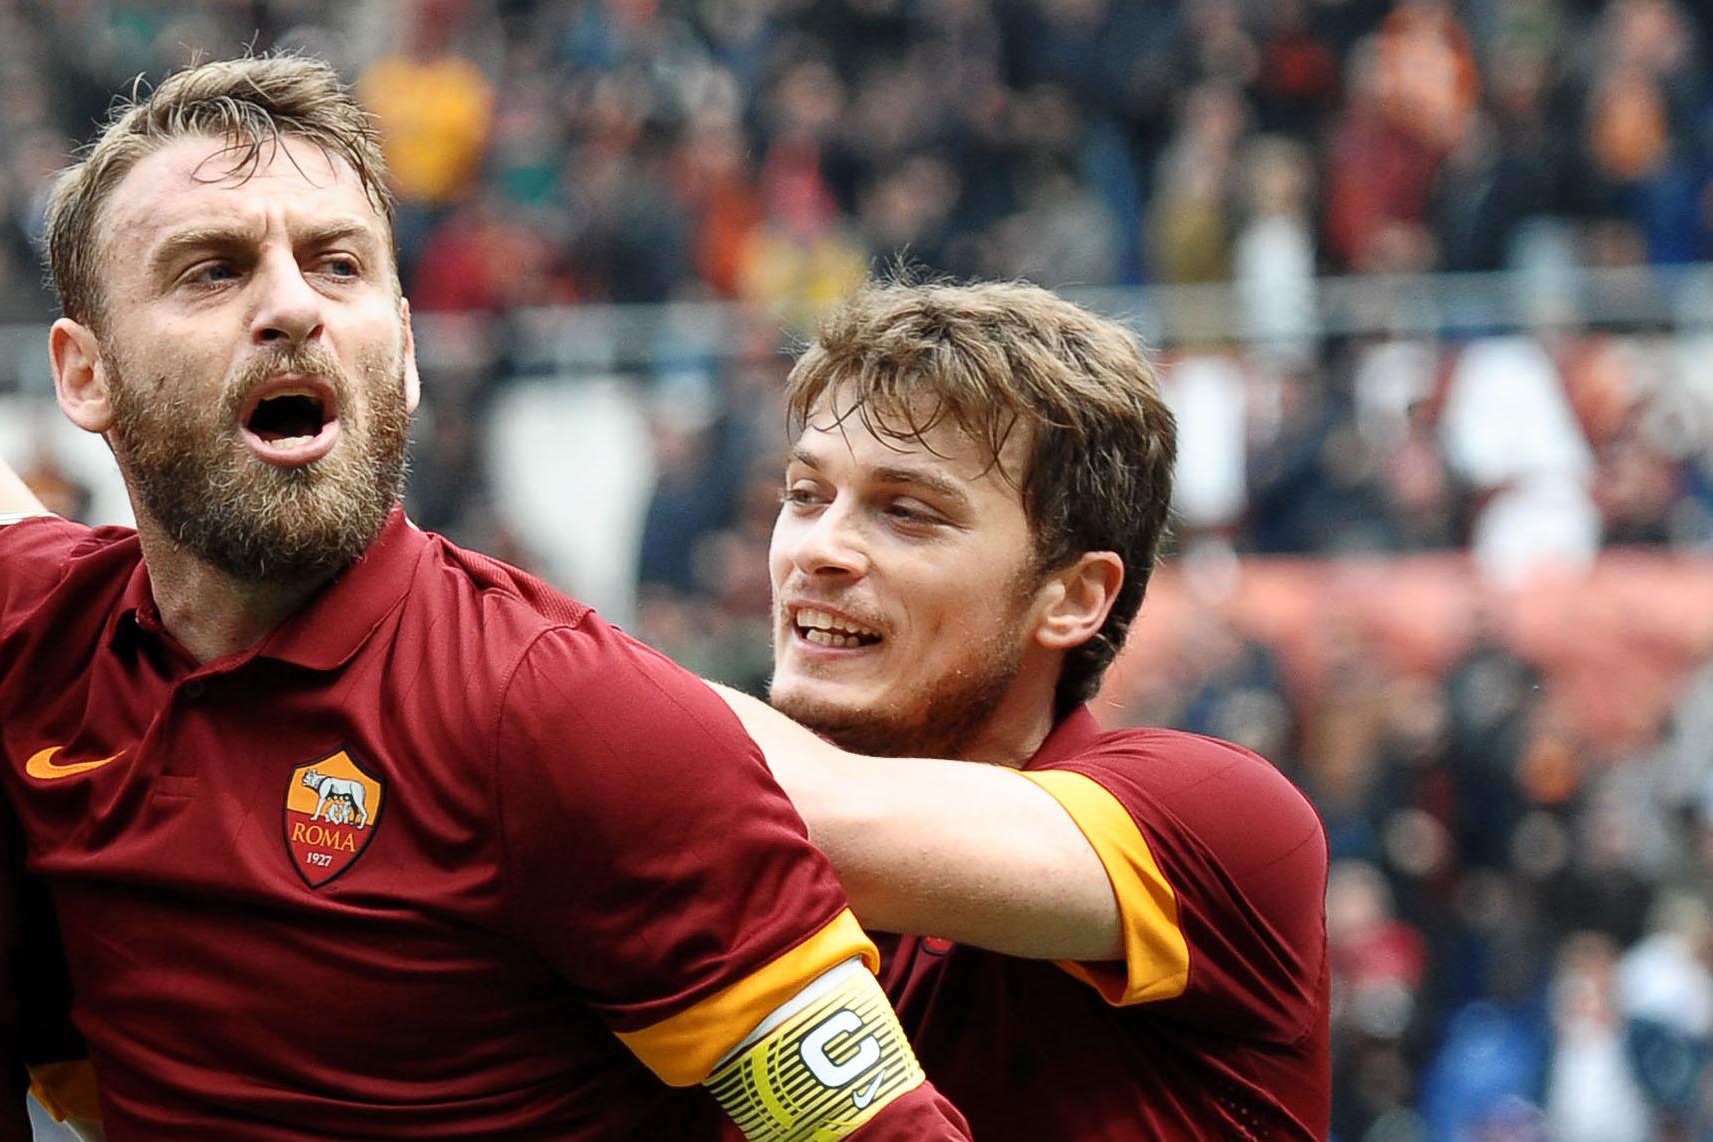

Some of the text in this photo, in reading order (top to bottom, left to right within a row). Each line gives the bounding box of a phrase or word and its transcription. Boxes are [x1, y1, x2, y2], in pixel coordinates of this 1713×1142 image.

[292, 822, 356, 852] ROMA
[306, 852, 333, 867] 1927
[800, 1008, 880, 1089] C
